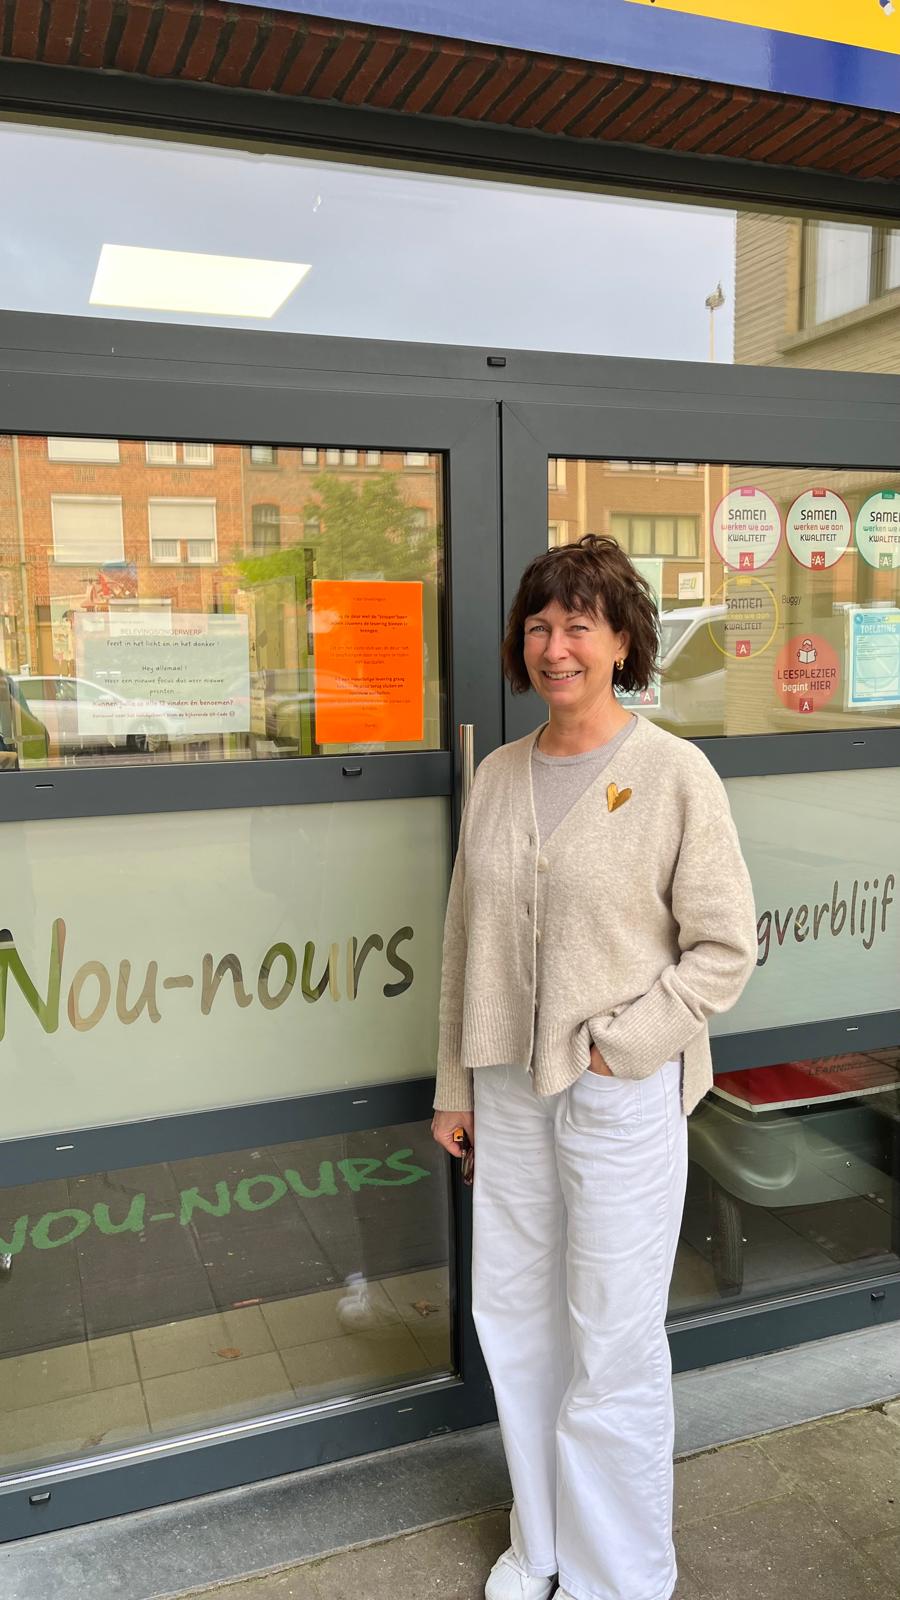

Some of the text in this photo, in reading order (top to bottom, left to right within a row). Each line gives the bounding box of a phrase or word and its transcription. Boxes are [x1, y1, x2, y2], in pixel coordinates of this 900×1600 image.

[728, 509, 767, 521] SAMEN
[800, 509, 838, 521] SAMEN
[870, 511, 900, 523] SAME
[721, 522, 747, 531] werken
[748, 523, 759, 531] we
[793, 523, 819, 531] werken
[727, 534, 767, 543] KWALITEIT
[800, 534, 838, 542] KWALITEIT
[725, 597, 763, 609] SAMEN
[781, 594, 802, 607] Buggy
[724, 622, 763, 632] KWALITEIT
[777, 668, 837, 680] LEESPLEZIER
[782, 680, 831, 694] begint HIER
[0, 917, 414, 1042] Nou-nours
